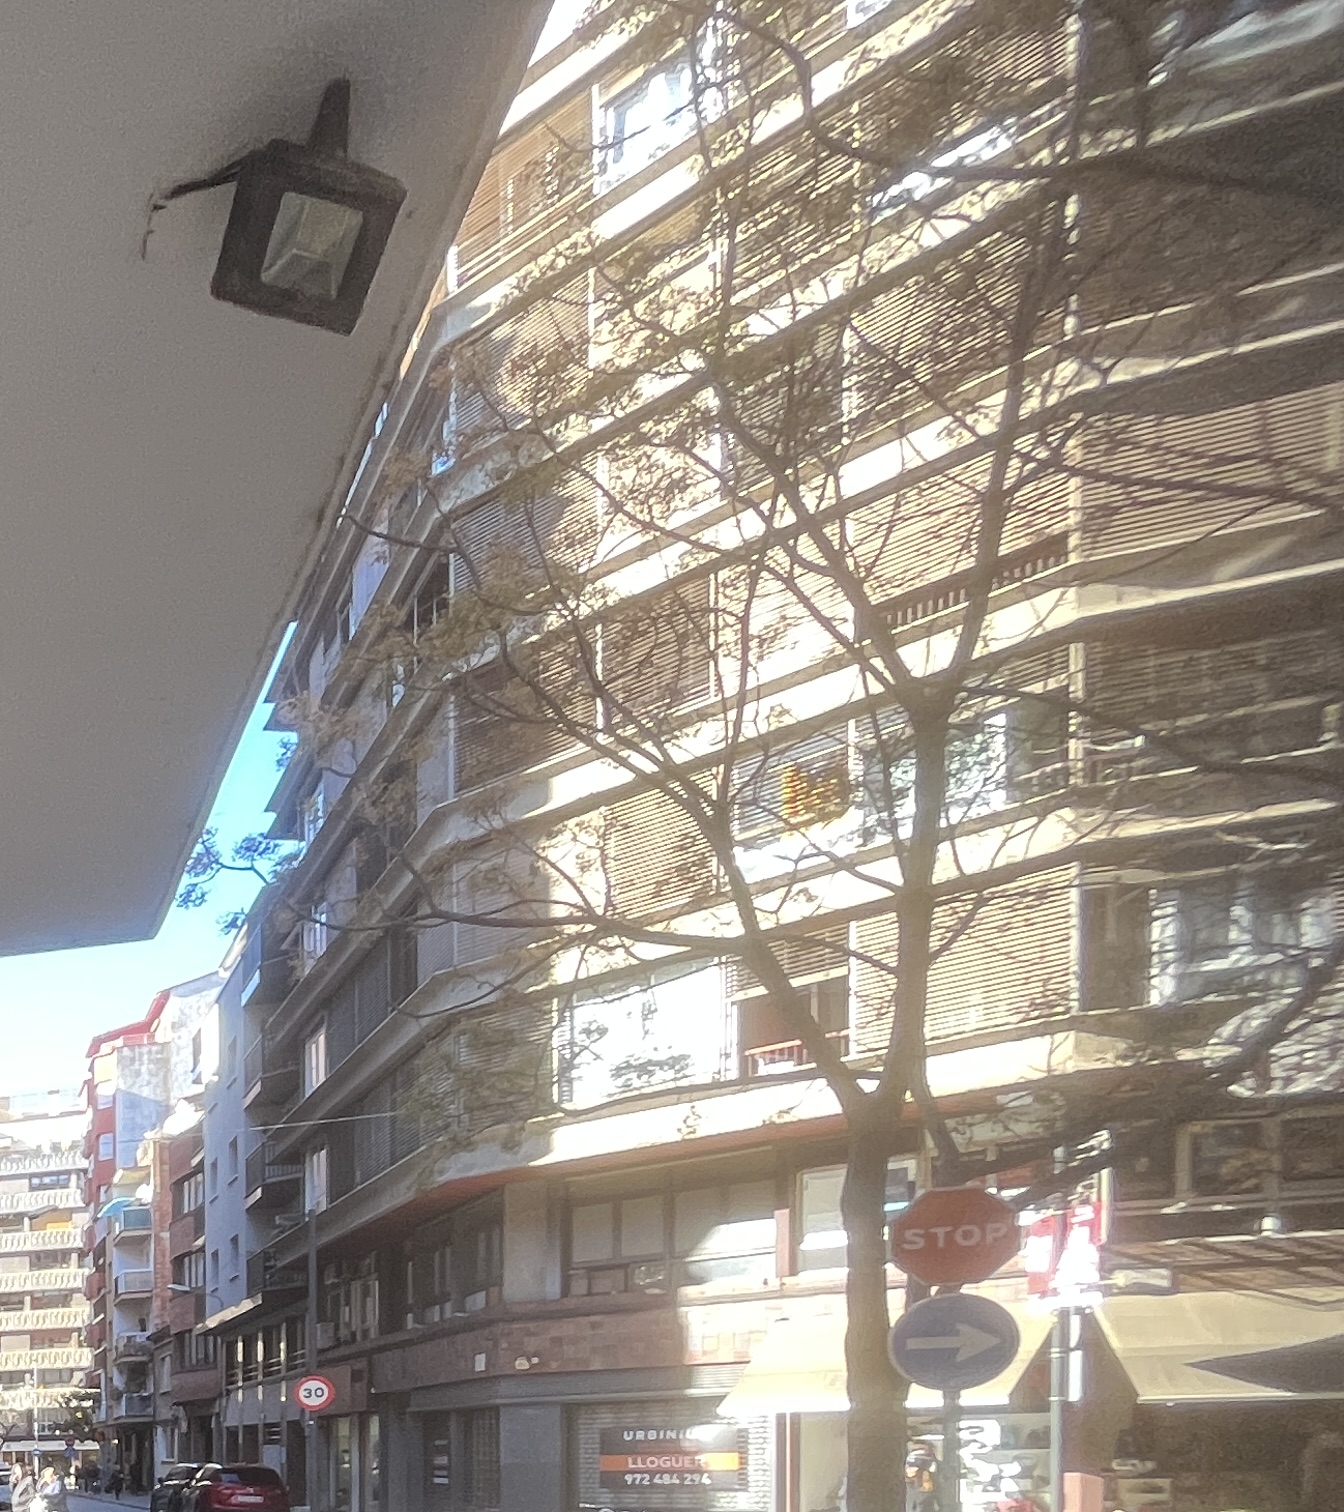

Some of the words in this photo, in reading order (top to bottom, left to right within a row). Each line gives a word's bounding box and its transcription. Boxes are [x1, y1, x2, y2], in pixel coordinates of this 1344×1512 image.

[901, 1222, 1009, 1250] STOP
[302, 1387, 325, 1399] 30
[624, 1473, 651, 1485] 972
